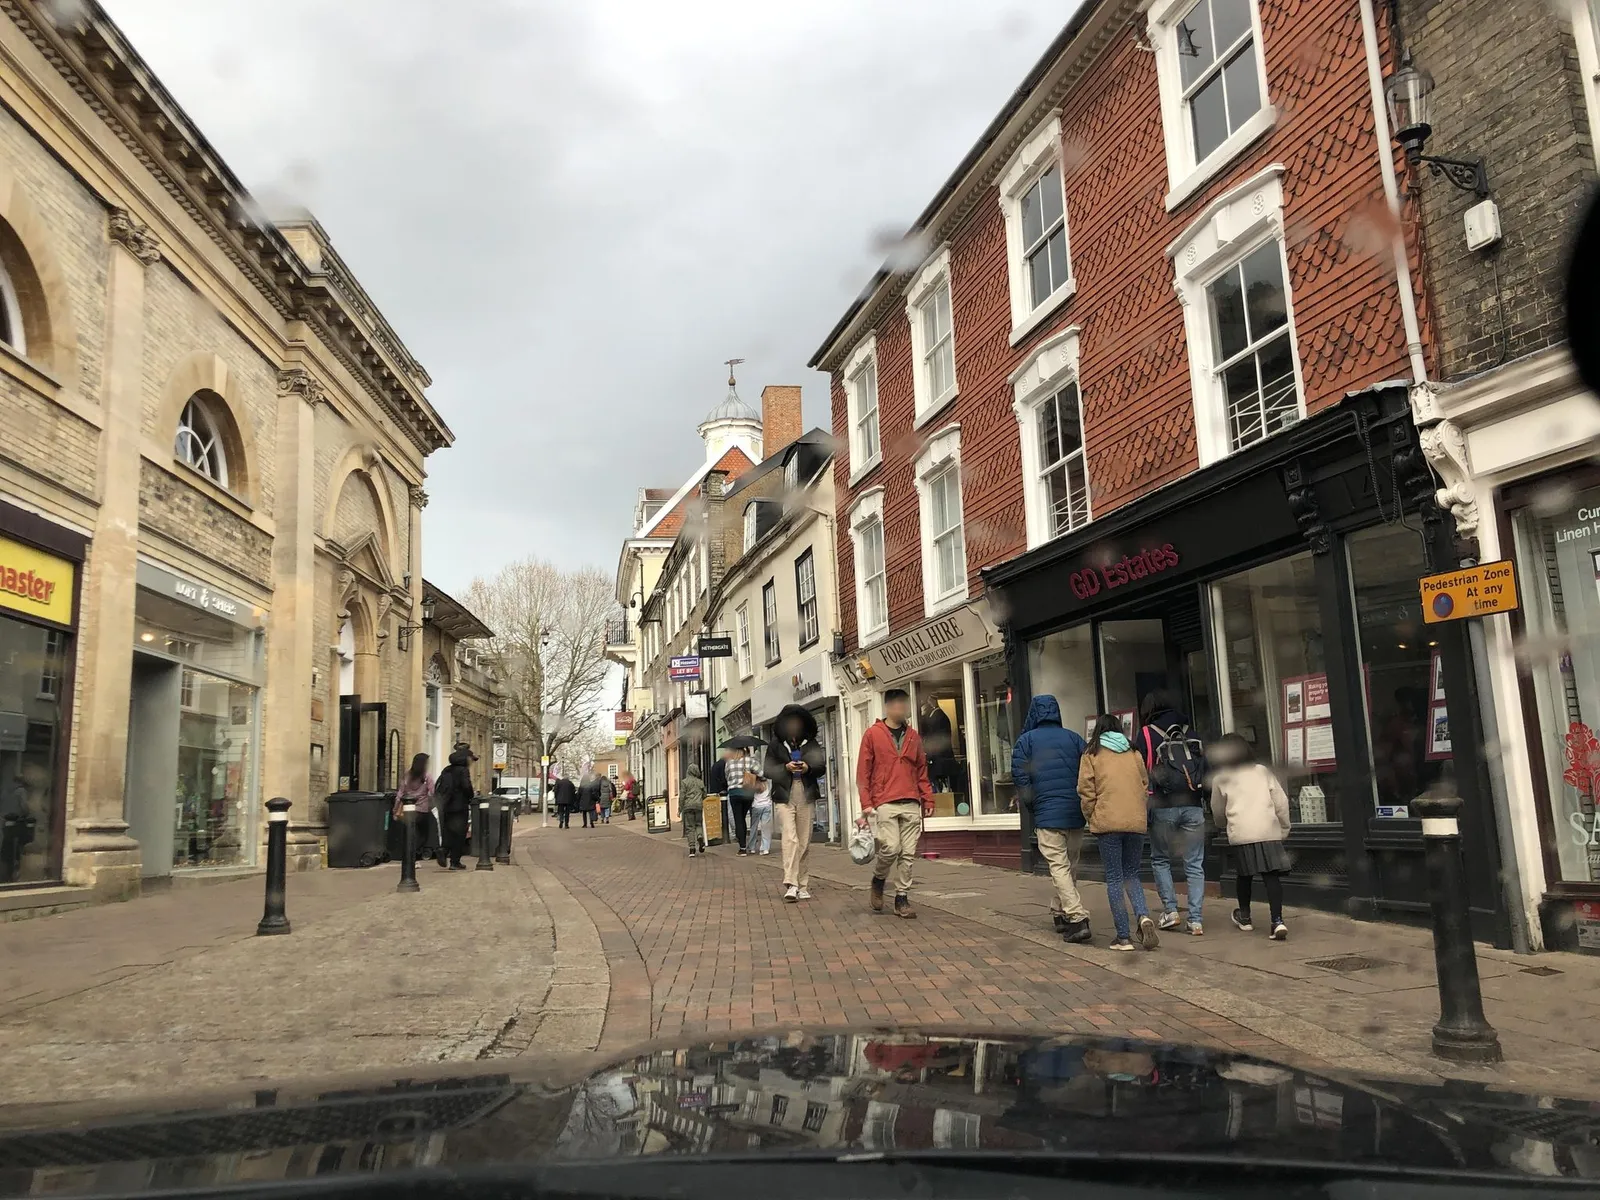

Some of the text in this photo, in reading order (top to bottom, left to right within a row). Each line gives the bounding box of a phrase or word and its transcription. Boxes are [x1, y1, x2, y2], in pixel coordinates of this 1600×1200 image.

[1556, 526, 1591, 543] Linen
[1069, 543, 1179, 600] GD Estates
[1423, 568, 1510, 592] Pedestrian Zone
[200, 588, 209, 608] &
[1466, 583, 1503, 598] At any
[1474, 598, 1498, 610] time
[879, 616, 964, 666] FORMAL HIRE
[842, 664, 859, 686] 13
[894, 664, 904, 674] BY
[902, 656, 926, 672] GERALD
